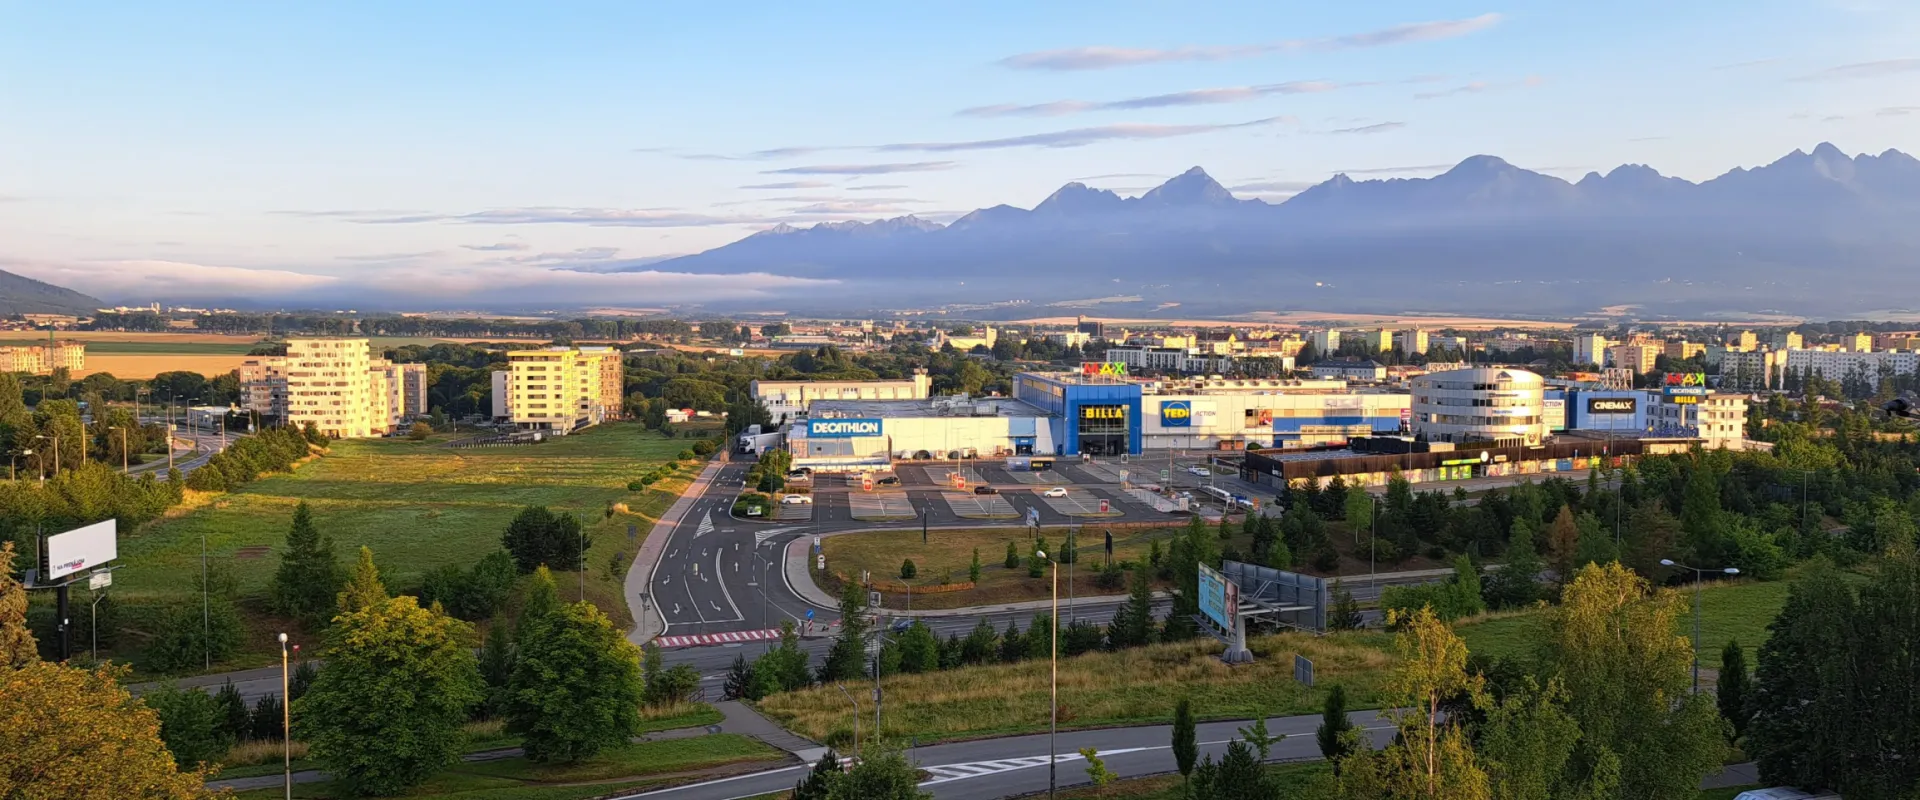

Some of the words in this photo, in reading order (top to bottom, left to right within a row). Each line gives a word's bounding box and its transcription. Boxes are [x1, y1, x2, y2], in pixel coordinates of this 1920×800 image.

[1083, 362, 1126, 375] MAX
[1666, 372, 1705, 385] MAX
[1594, 401, 1633, 410] CINEMAX
[1086, 408, 1123, 418] BILLA
[813, 422, 878, 433] DECATHLON
